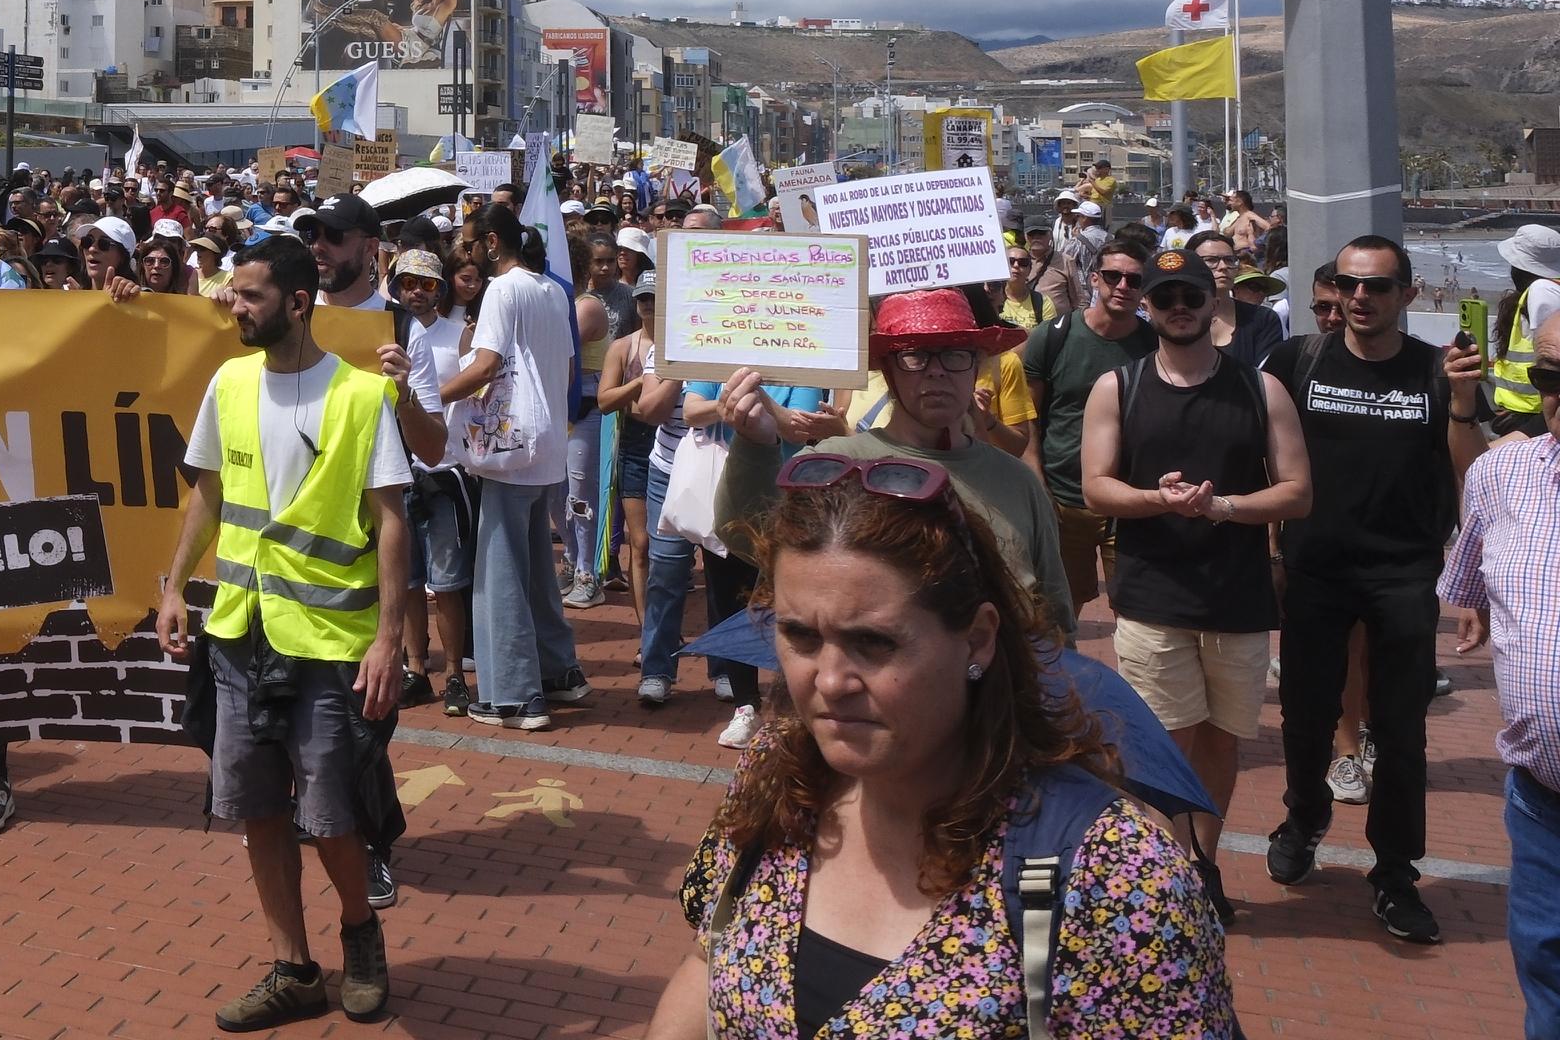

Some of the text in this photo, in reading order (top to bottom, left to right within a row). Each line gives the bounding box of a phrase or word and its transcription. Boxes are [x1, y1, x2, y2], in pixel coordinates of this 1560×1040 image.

[545, 32, 577, 40] FABRICAMOS
[346, 41, 423, 59] GUESS
[946, 125, 982, 133] CANARIA
[947, 136, 955, 144] EL
[790, 168, 815, 177] FAUNA
[778, 175, 832, 189] AMENAZADA
[822, 175, 983, 206] NOO AL ROBO DE LA LEY DE LA DEPENDENCIA A
[828, 194, 985, 231] NUESTRAS MAYORES Y DISCAPACITADAS
[903, 228, 947, 248] PÚBLICAS
[949, 225, 984, 240] DIGNAS
[878, 249, 895, 266] LOS
[897, 243, 946, 265] DERECHOS
[946, 240, 996, 259] HUMANOS
[884, 262, 950, 287] ARTICULO 25
[705, 289, 804, 301] UN DERECHO
[733, 304, 757, 315] QUE
[691, 315, 710, 324] EL
[786, 322, 808, 331] DE
[695, 333, 733, 347] GRAN
[1313, 384, 1424, 405] DEFENDER LA Alegría
[1311, 400, 1424, 421] ORGANIZAR LA RABIA
